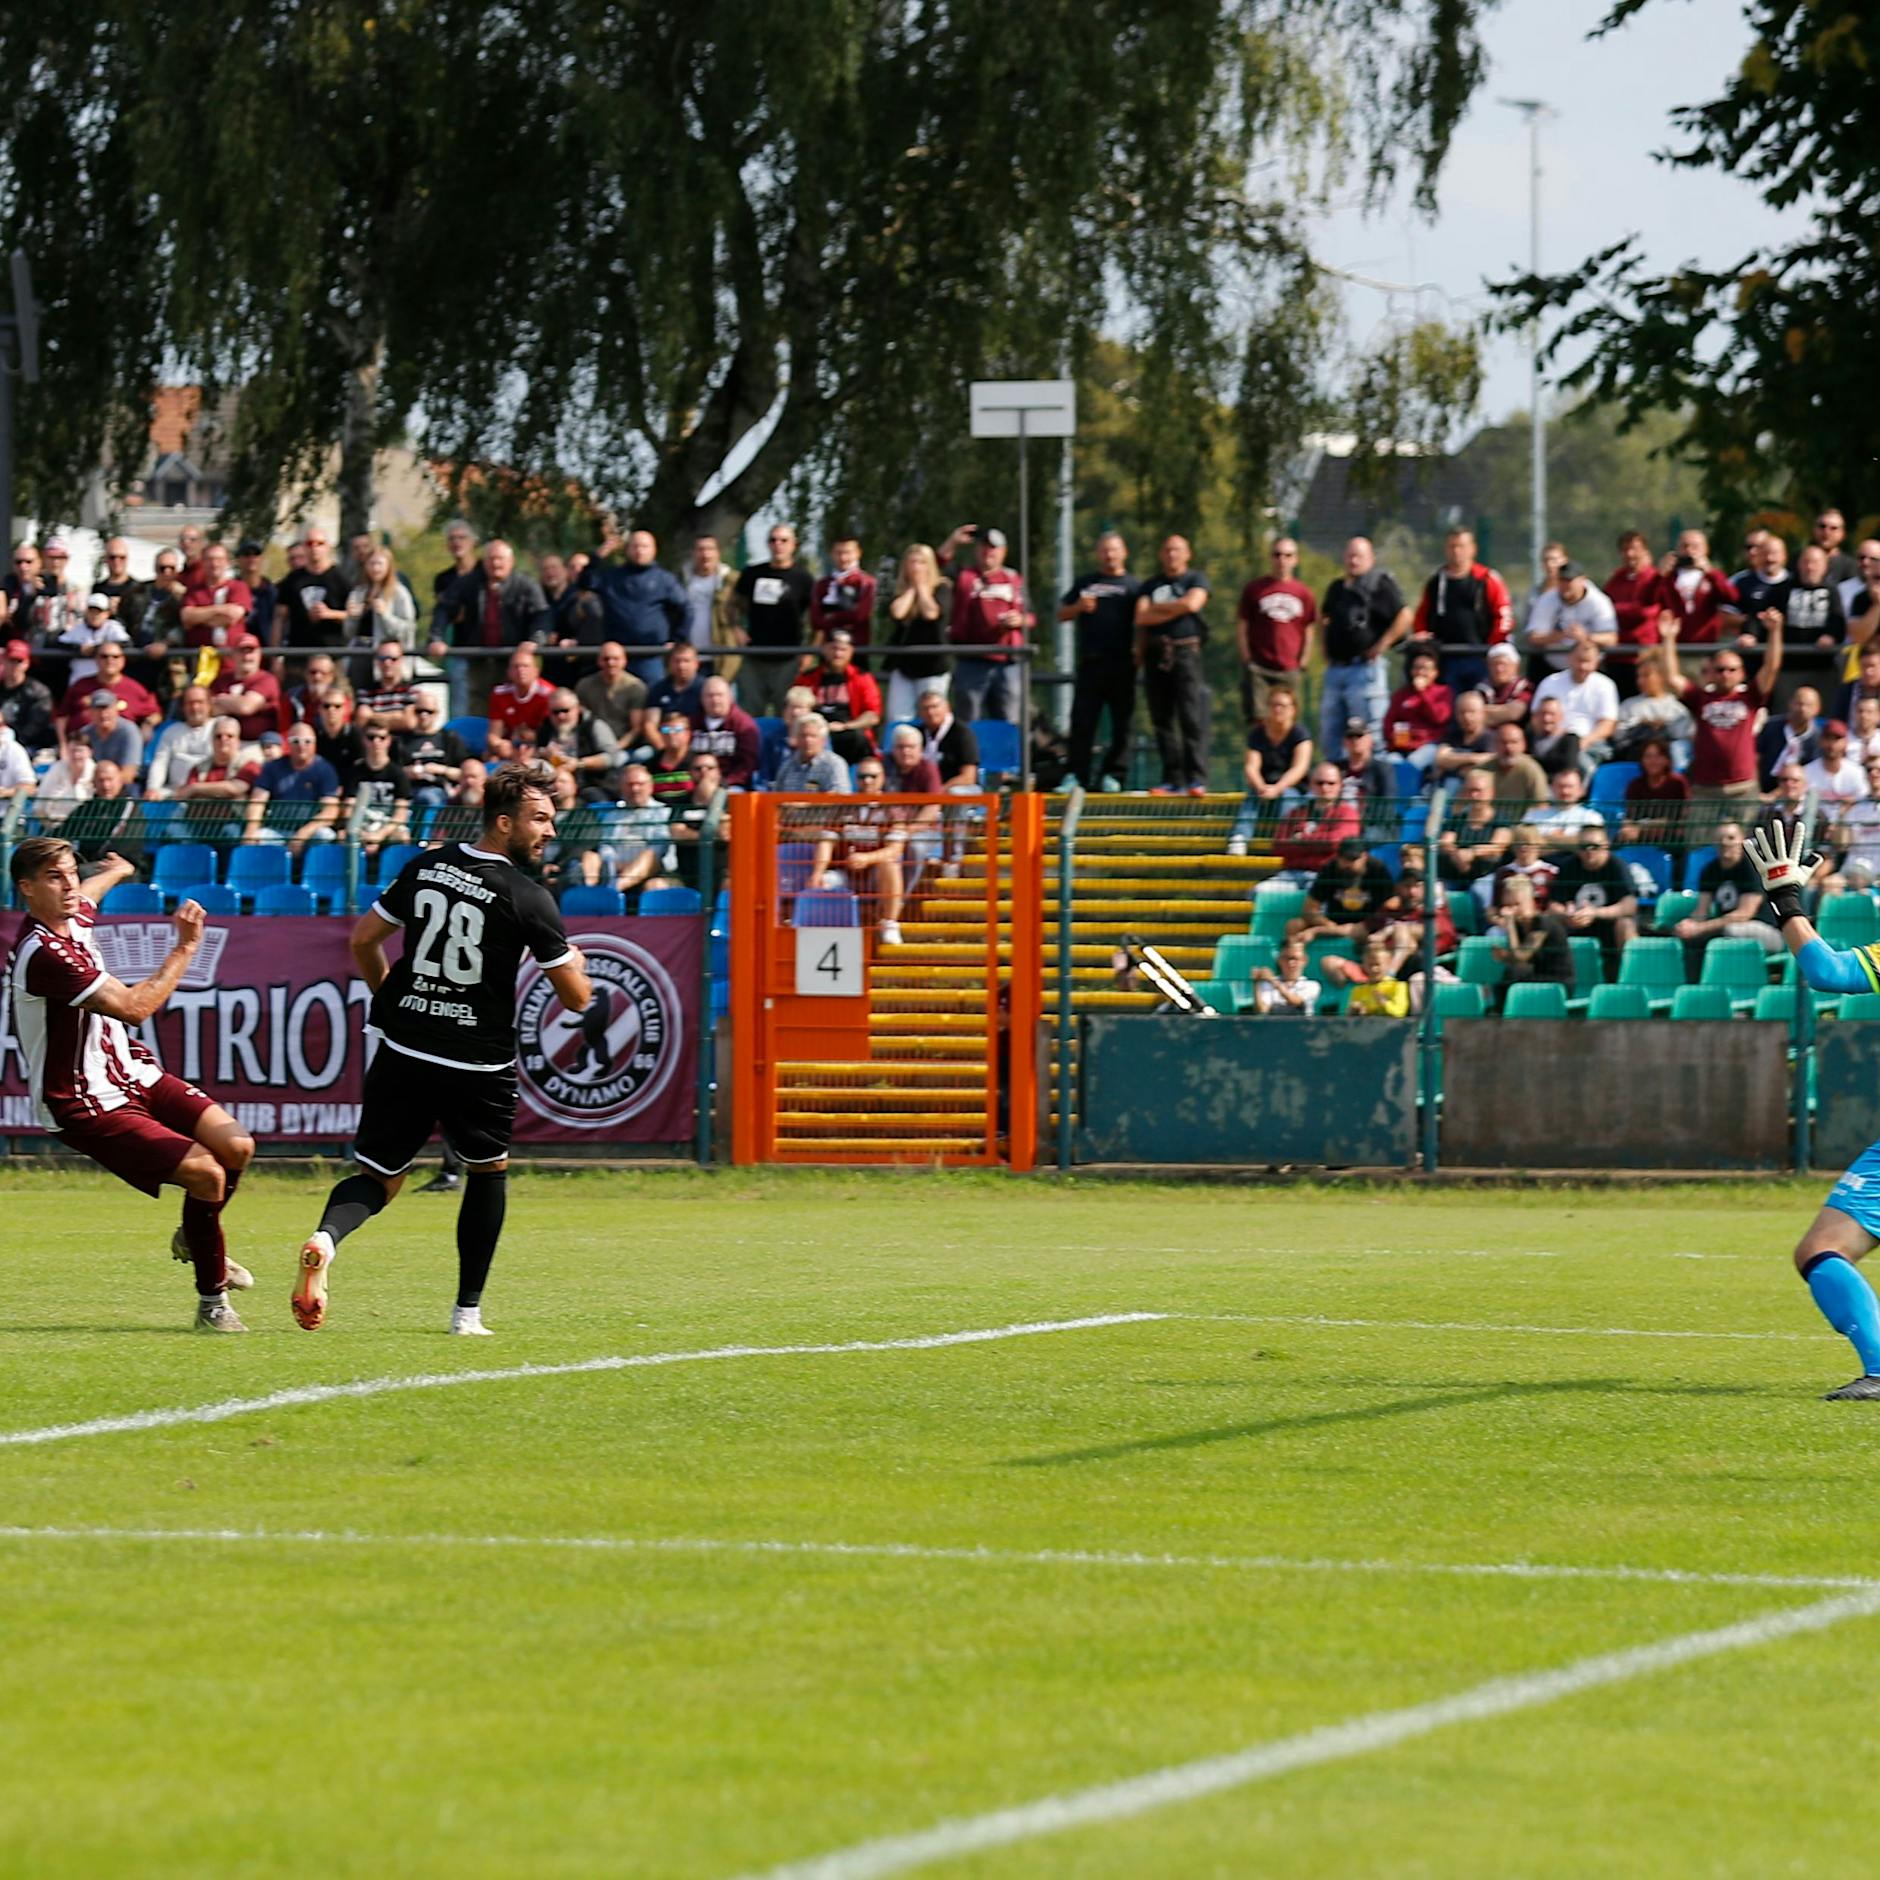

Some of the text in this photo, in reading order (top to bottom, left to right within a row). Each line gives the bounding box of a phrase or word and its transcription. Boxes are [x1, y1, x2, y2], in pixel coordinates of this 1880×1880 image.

[413, 889, 484, 984] 28
[816, 942, 843, 981] 4
[429, 1000, 478, 1019] ENGEL
[520, 976, 556, 1044] BERLIN
[585, 957, 647, 998] SSBALL
[544, 1075, 635, 1104] DYNAMO
